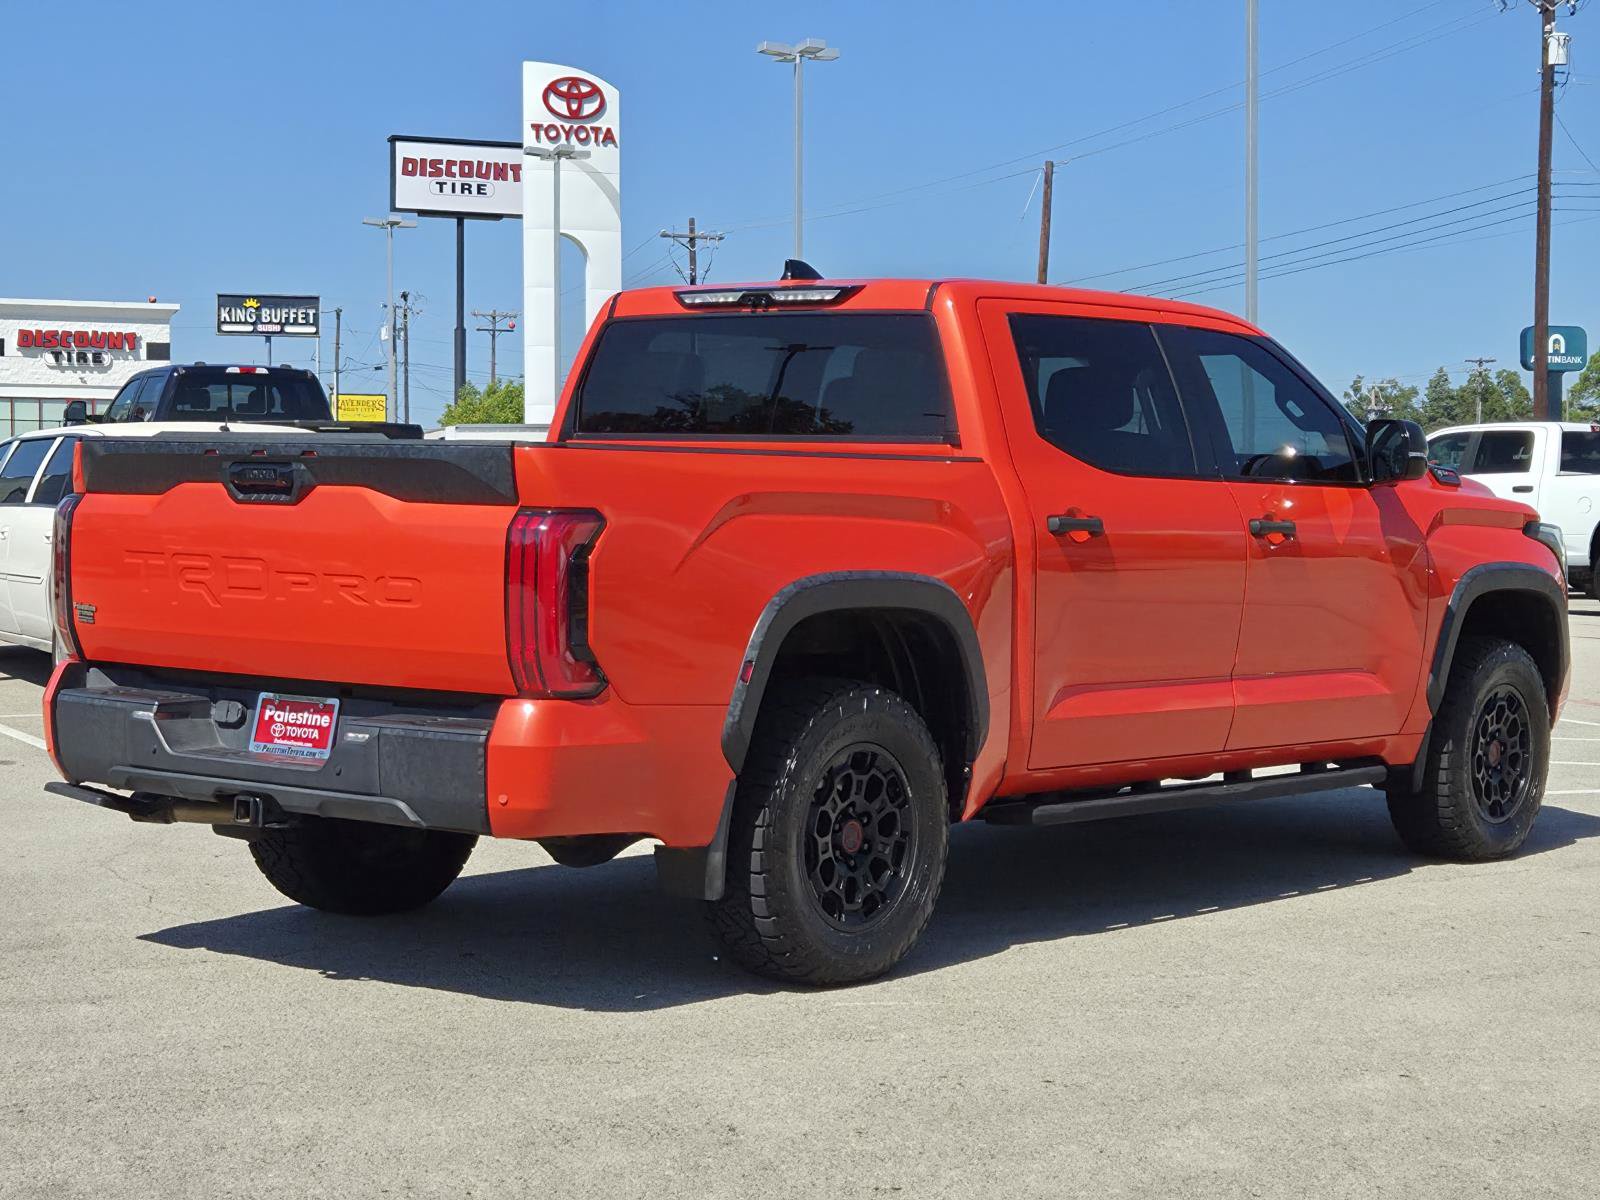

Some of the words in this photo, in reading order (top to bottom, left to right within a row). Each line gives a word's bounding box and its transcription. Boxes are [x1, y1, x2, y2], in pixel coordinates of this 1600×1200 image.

[531, 123, 618, 147] TOYOTA
[401, 157, 522, 182] DISCOUNT
[435, 181, 488, 196] TIRE
[220, 306, 256, 323] KING
[261, 307, 316, 324] BUFFET
[257, 324, 281, 332] SUSHI
[17, 329, 137, 350] DISCOUNT
[50, 350, 104, 364] TIRE
[338, 399, 385, 411] AVENDER'S
[123, 550, 268, 608] TRD
[274, 570, 423, 608] PRO
[264, 705, 329, 727] Palestine
[286, 726, 319, 739] TOYOTA
